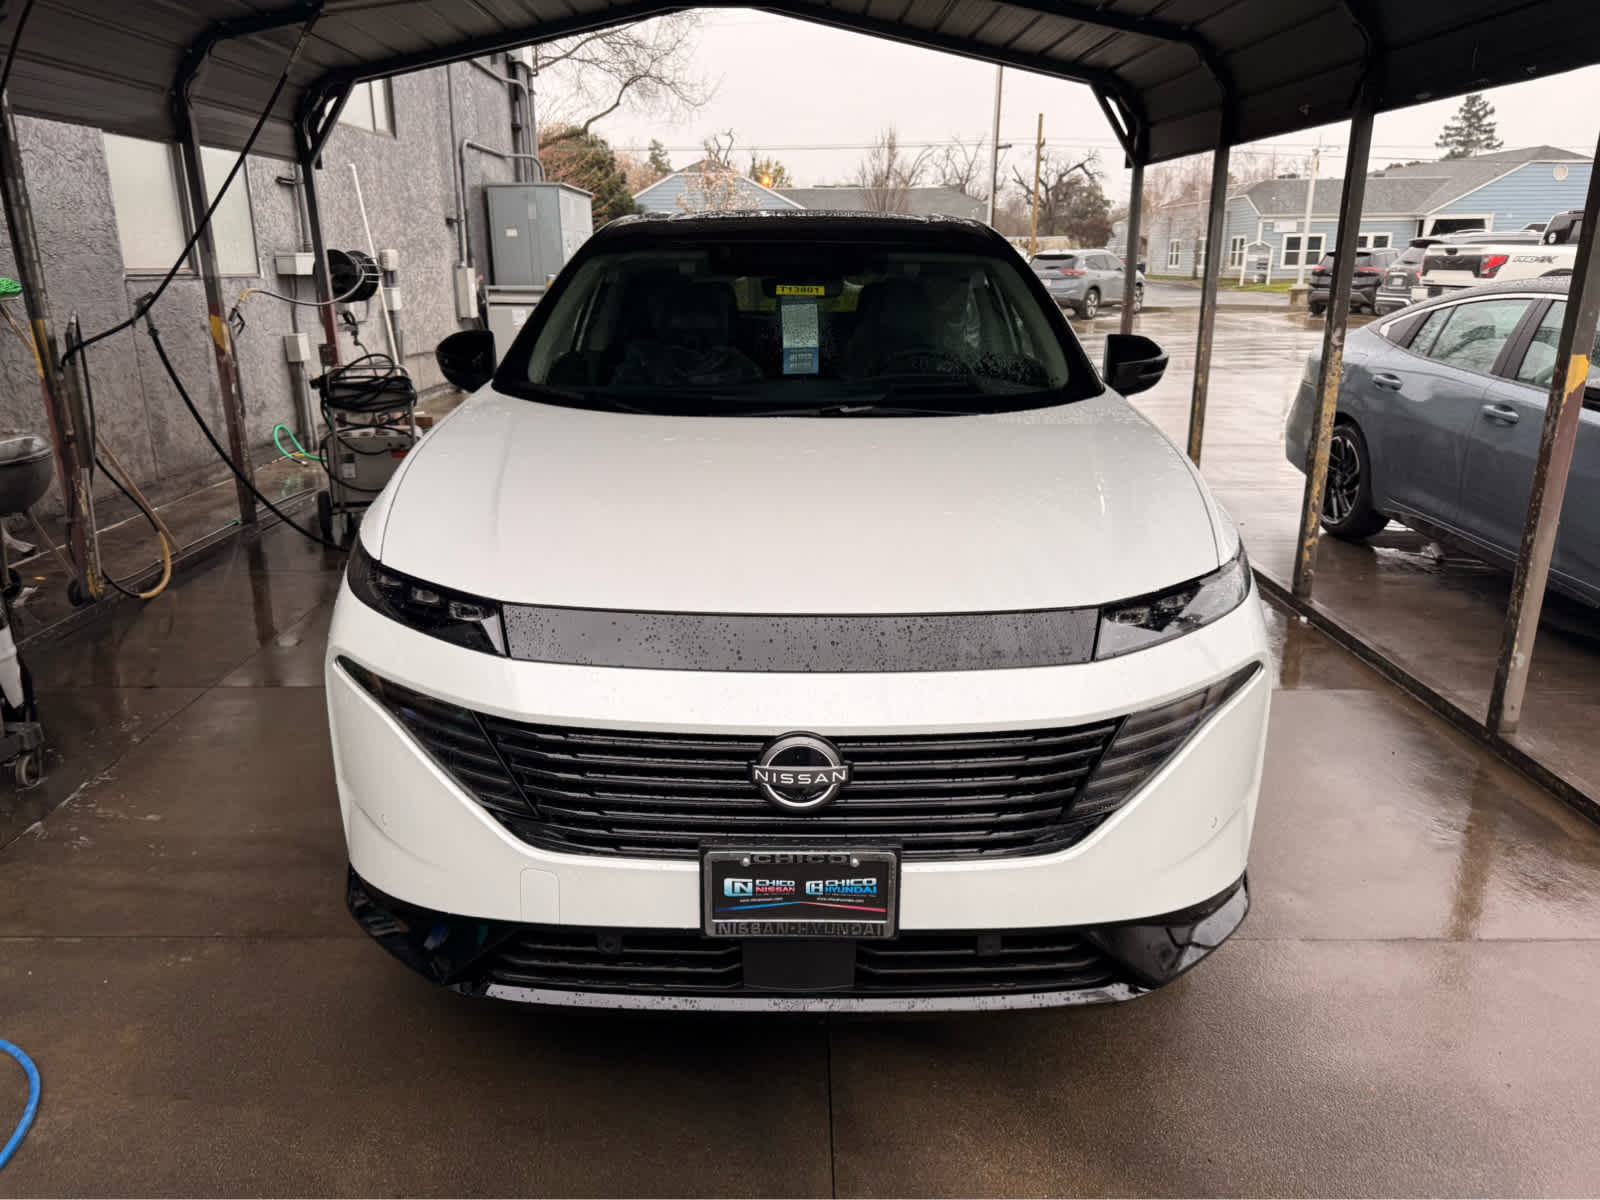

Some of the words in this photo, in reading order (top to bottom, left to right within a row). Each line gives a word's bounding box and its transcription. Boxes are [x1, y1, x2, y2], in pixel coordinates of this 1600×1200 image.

[754, 769, 846, 785] NISSAN
[753, 854, 848, 864] CHICO
[755, 879, 796, 887] CHICO
[825, 878, 877, 887] CHICO
